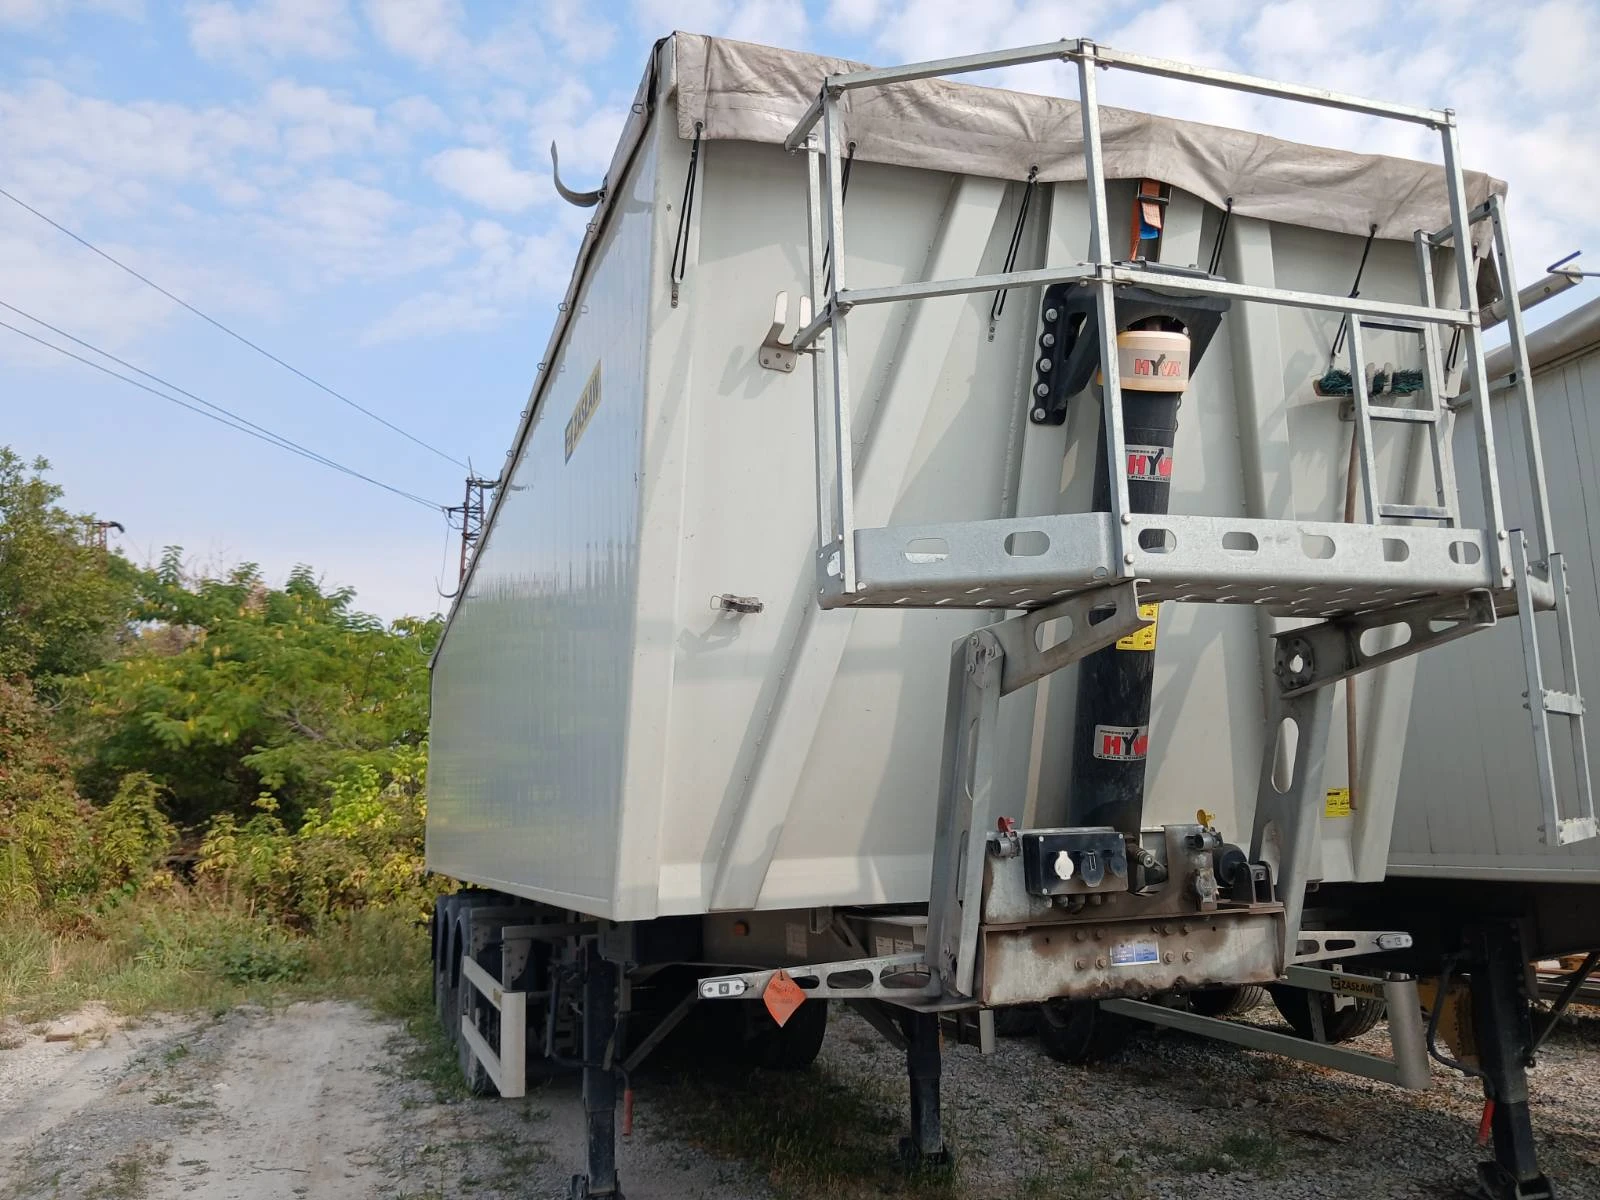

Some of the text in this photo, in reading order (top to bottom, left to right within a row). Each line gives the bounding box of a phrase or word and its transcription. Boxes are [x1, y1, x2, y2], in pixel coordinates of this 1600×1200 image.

[1135, 354, 1181, 376] HYVA
[1128, 448, 1172, 476] HYV
[1103, 728, 1148, 756] HYV
